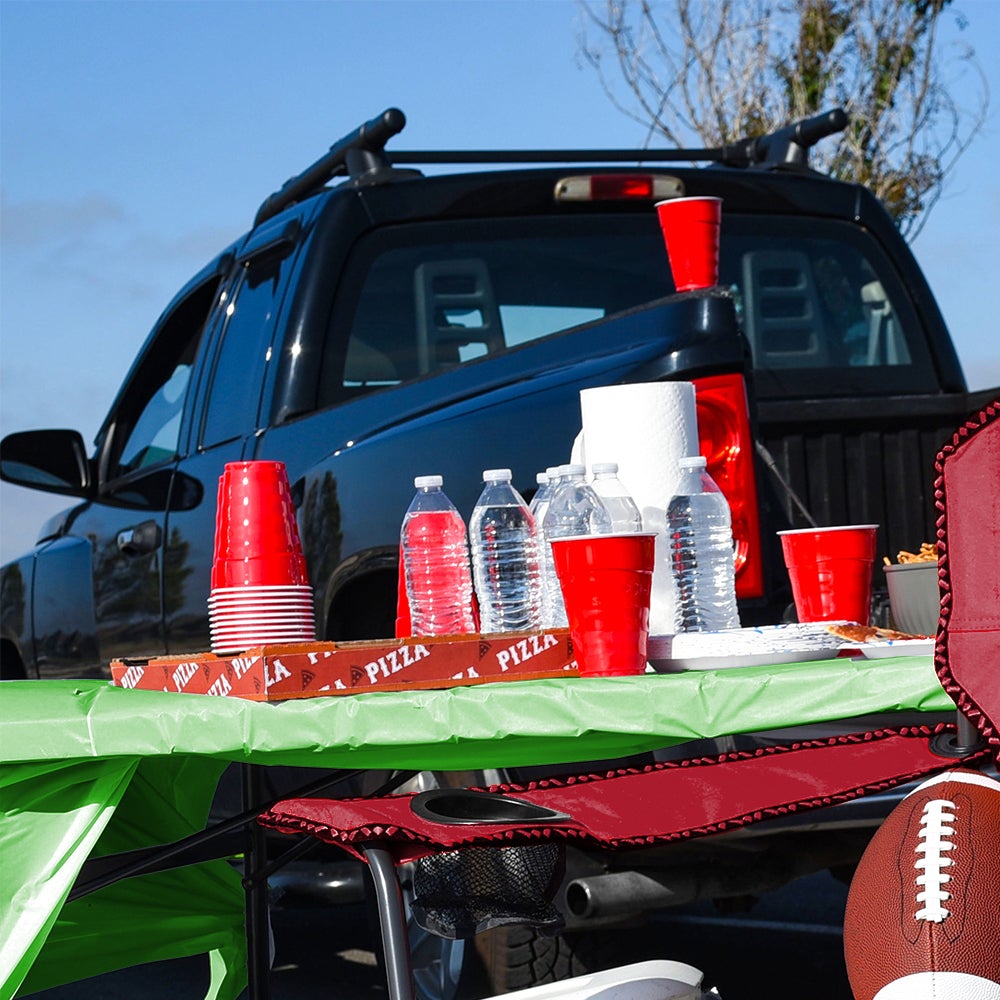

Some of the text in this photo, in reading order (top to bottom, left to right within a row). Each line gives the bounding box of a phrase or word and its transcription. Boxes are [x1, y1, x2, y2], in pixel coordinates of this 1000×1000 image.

[364, 644, 430, 684] PIZZA
[496, 634, 559, 672] PIZZA
[172, 662, 199, 693] PIZZA
